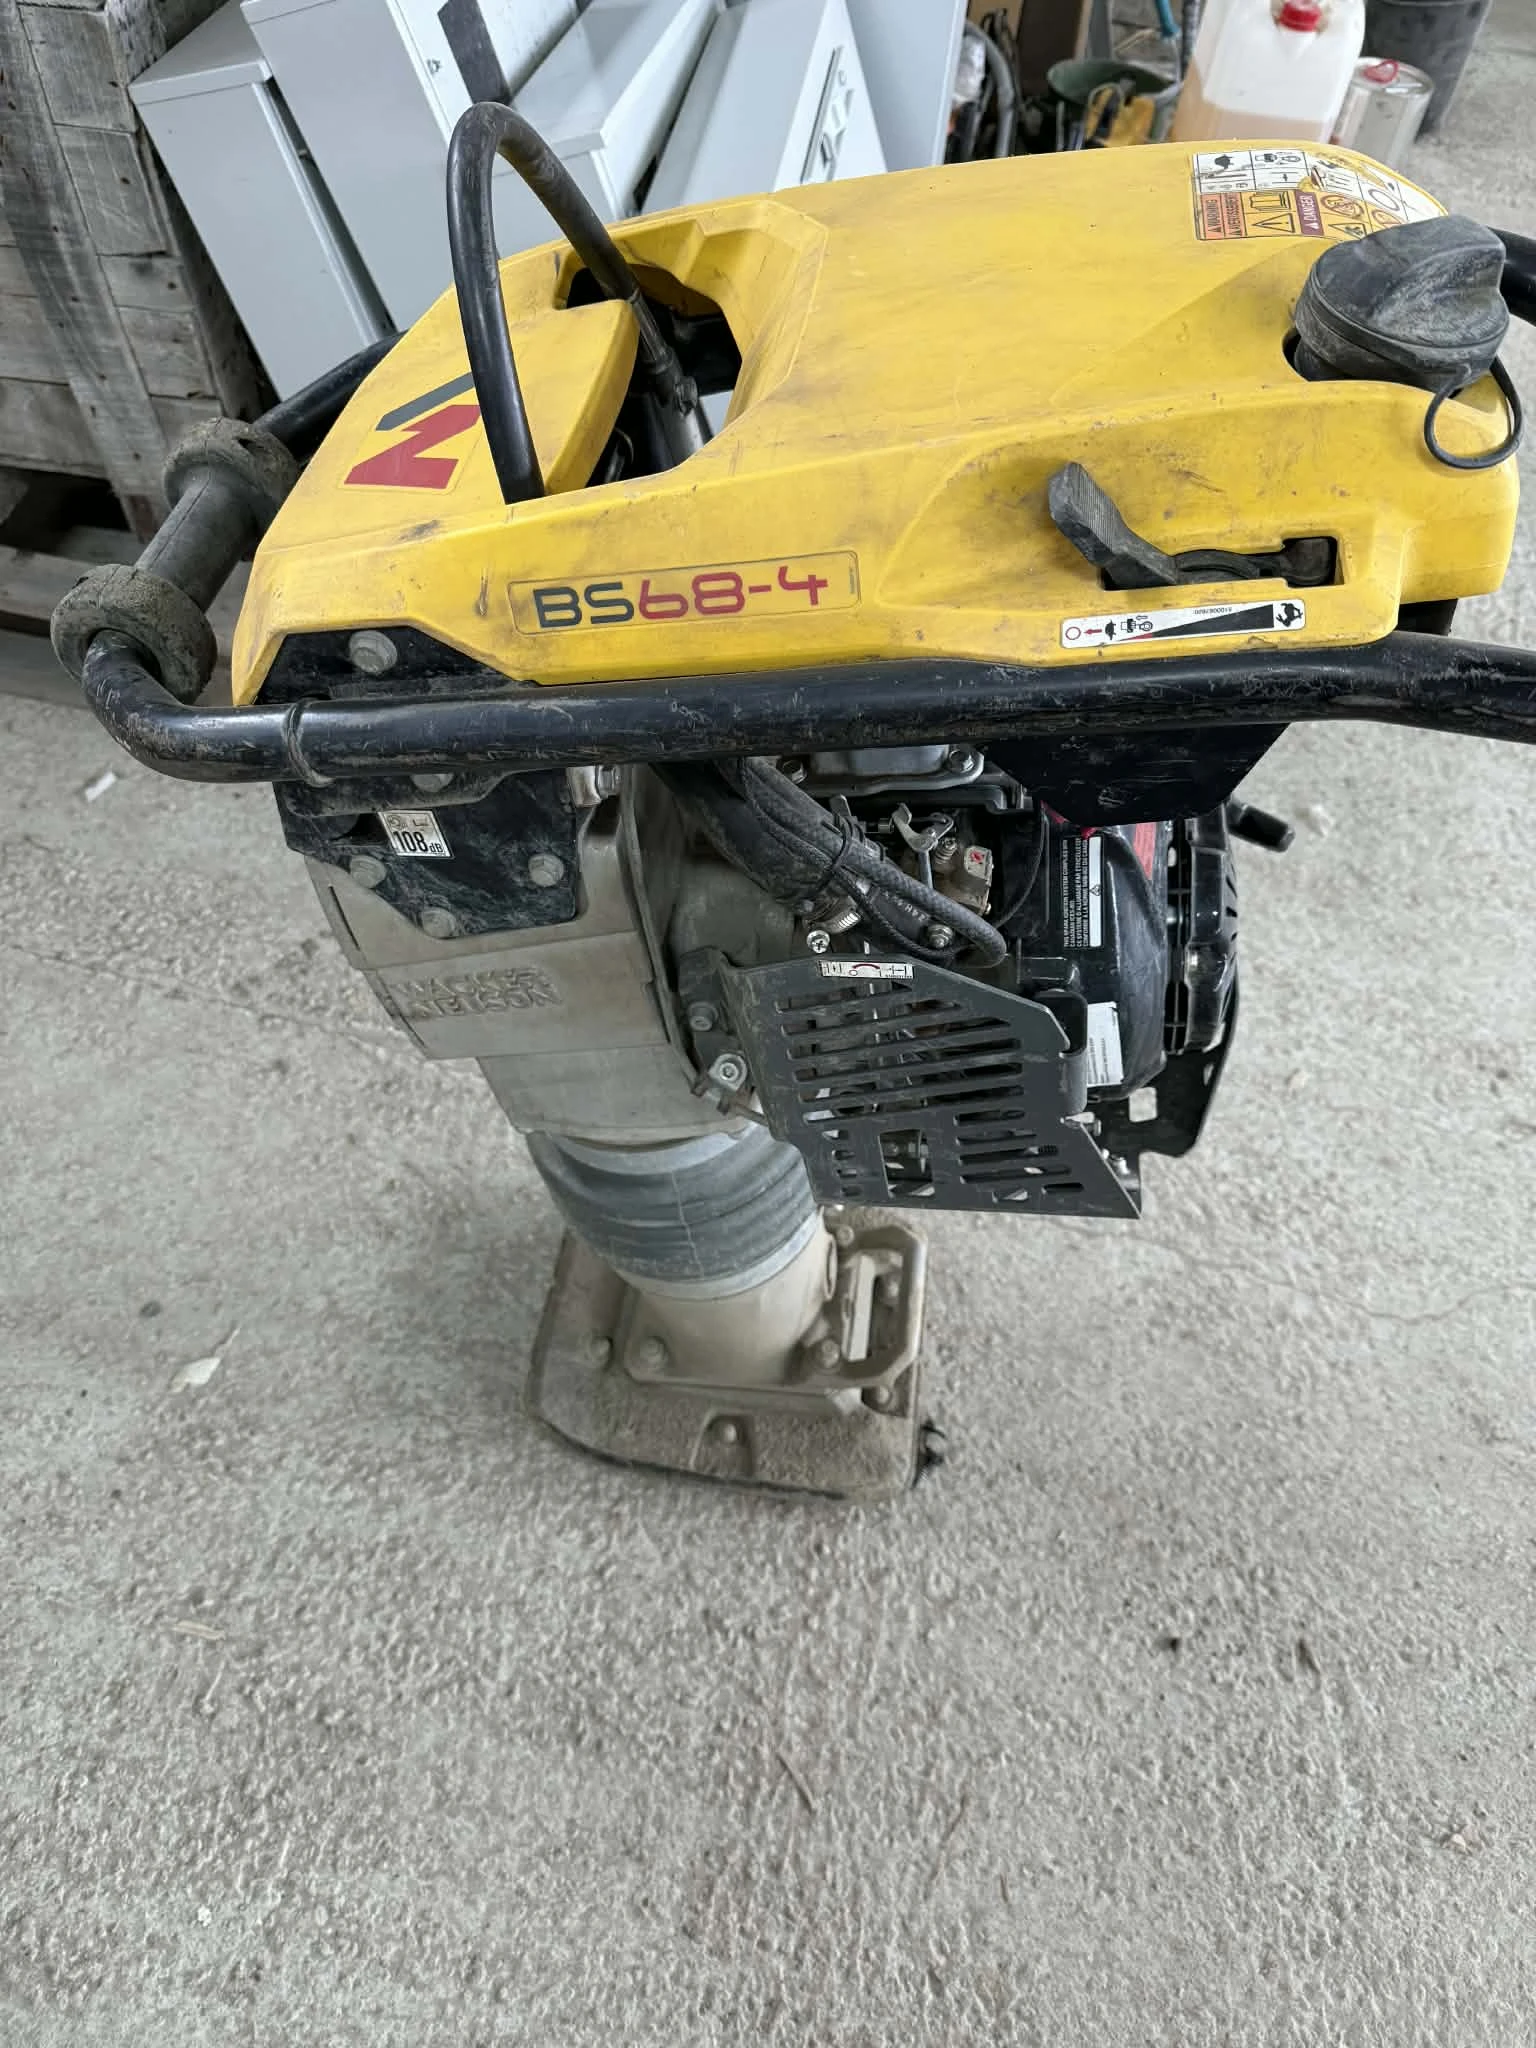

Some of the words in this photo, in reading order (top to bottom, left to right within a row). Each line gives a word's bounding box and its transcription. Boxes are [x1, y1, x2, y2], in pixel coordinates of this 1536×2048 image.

[1207, 199, 1220, 228] WARNING
[1300, 195, 1318, 221] DANGER
[532, 565, 829, 629] BS68-4
[393, 831, 428, 852] 108
[429, 842, 444, 853] dB
